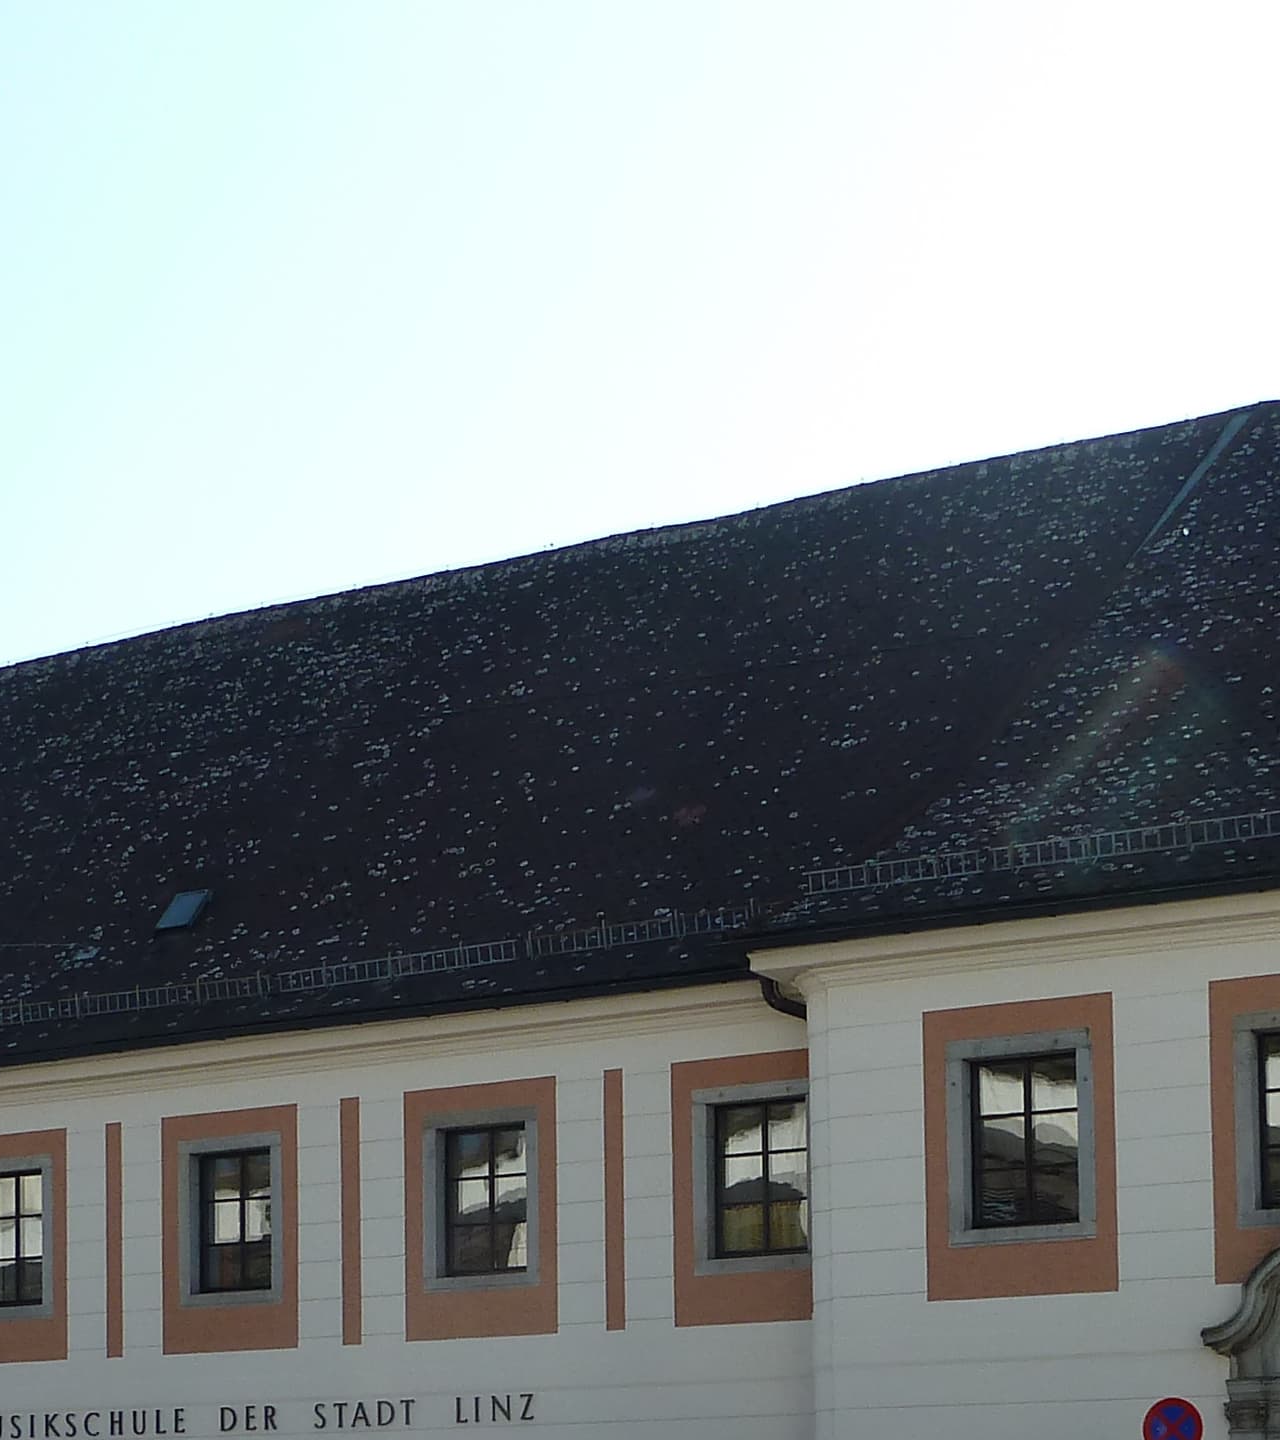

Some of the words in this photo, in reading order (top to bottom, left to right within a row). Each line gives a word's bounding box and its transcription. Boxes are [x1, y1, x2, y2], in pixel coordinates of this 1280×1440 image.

[220, 1404, 278, 1431] DER
[313, 1399, 416, 1430] STADT
[455, 1393, 535, 1424] LINZ
